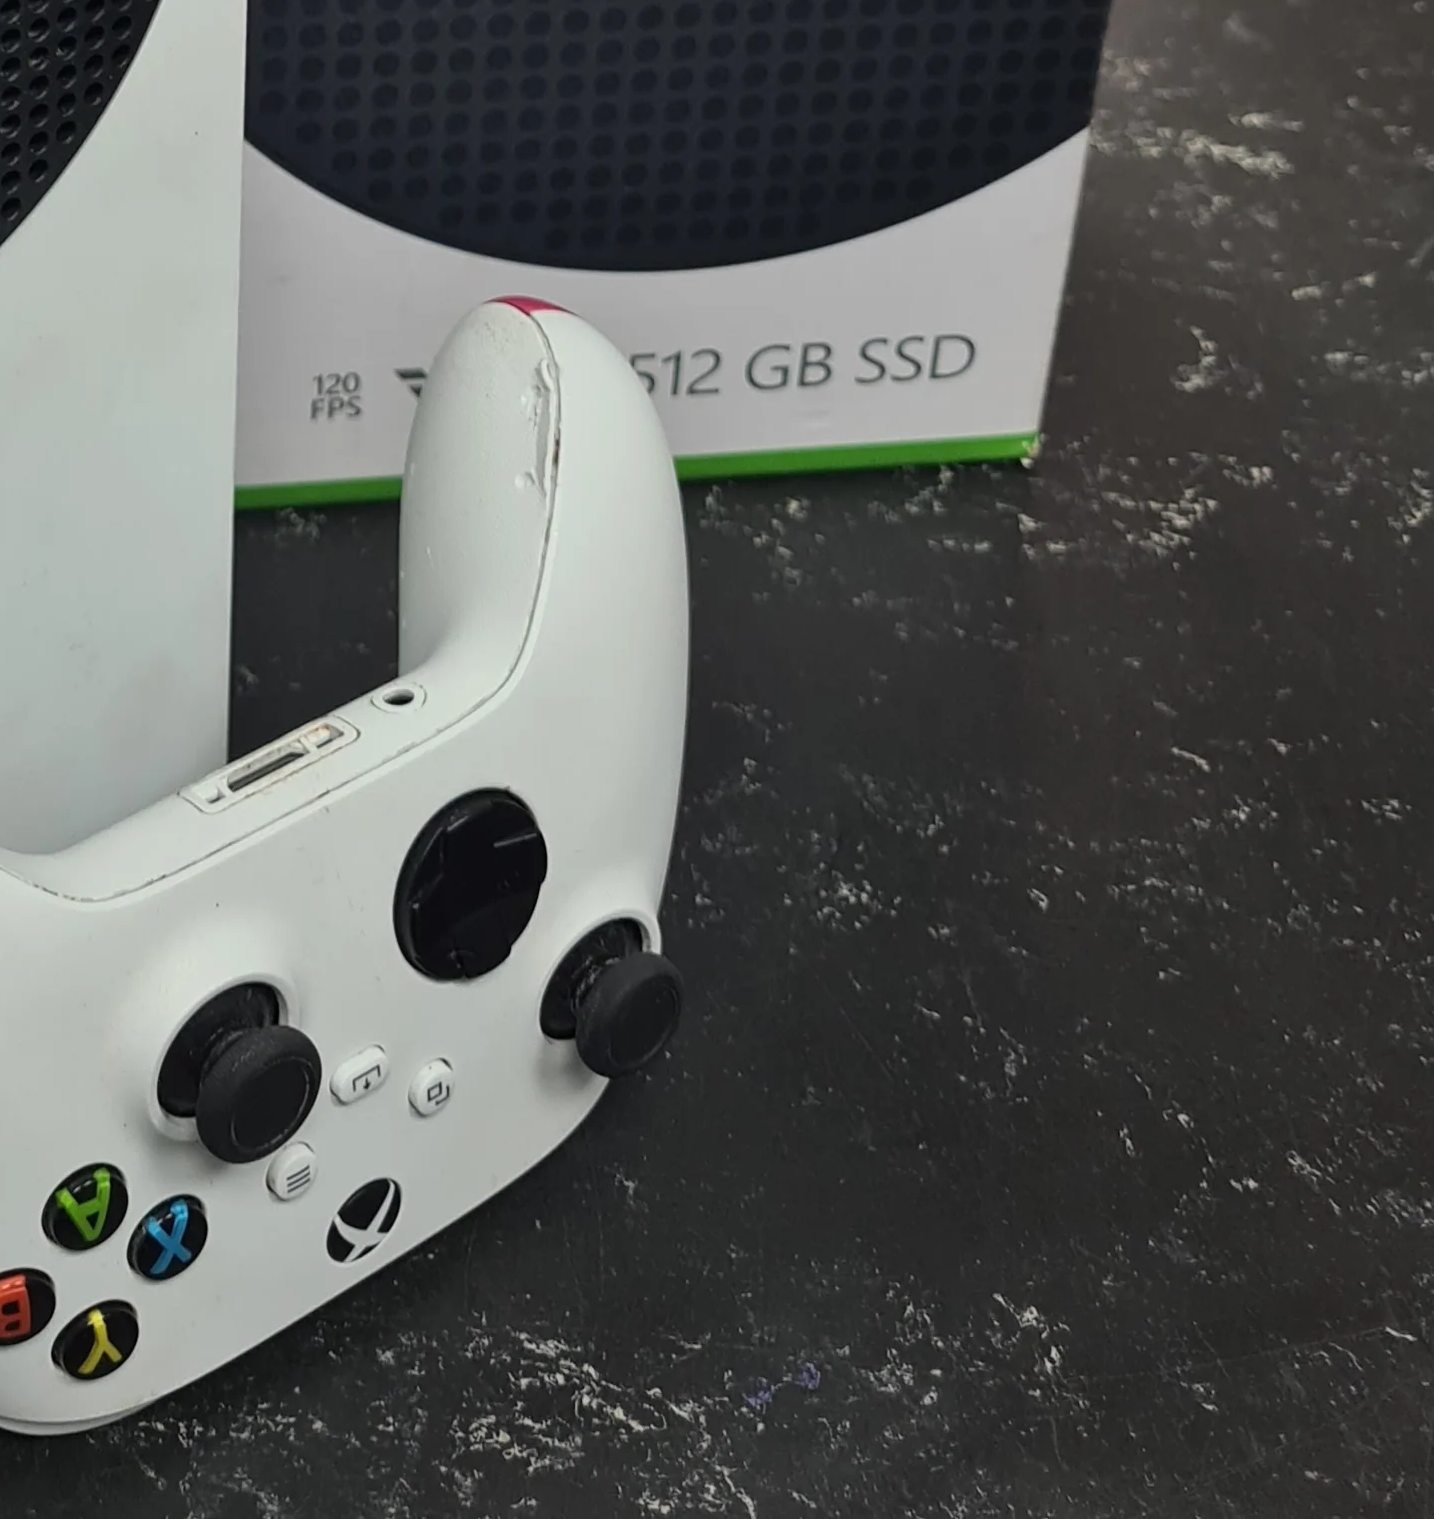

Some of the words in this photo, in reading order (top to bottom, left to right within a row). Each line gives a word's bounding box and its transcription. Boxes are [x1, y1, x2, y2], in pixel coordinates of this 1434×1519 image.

[312, 371, 361, 395] 120
[628, 347, 722, 397] 512
[745, 341, 833, 390] GB
[854, 334, 976, 384] SSD
[310, 395, 362, 420] FPS
[55, 1167, 111, 1242] A
[146, 1198, 192, 1274] X
[77, 1308, 123, 1374] Y
